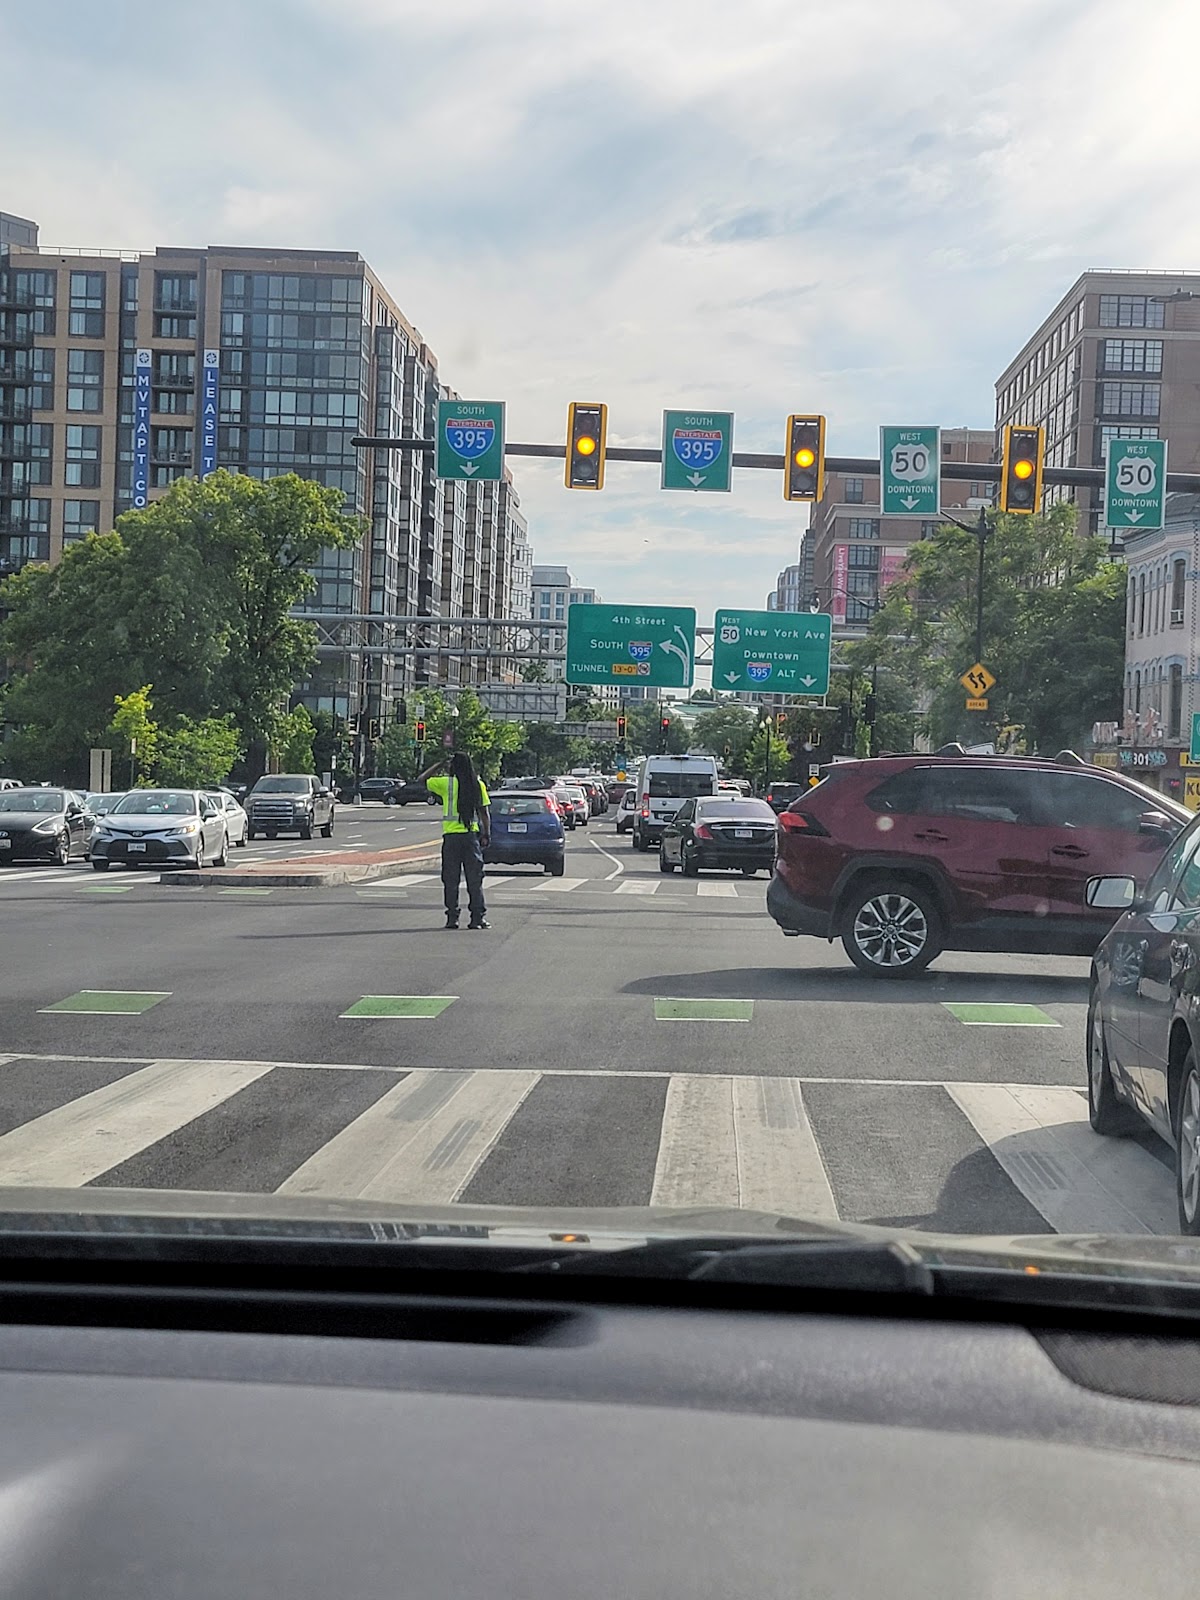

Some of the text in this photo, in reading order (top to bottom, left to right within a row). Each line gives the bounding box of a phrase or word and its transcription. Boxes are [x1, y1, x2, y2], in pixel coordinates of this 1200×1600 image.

[204, 371, 216, 446] LEASE
[456, 406, 485, 416] SOUTH
[450, 421, 490, 429] INTERSTATE
[684, 416, 713, 426] SOUTH
[453, 430, 487, 449] 395
[679, 431, 717, 440] INTERSTATE
[900, 432, 921, 441] WEST
[681, 440, 715, 460] 395
[1126, 445, 1148, 455] WEST
[895, 451, 927, 473] 50
[1120, 465, 1153, 486] 50
[887, 485, 933, 495] DOWNTOWN
[1111, 498, 1159, 508] DOWNTOWN
[611, 616, 666, 626] 4th Street
[721, 616, 740, 624] WEST
[722, 629, 738, 640] 50
[745, 627, 826, 640] New York Ave
[590, 638, 624, 650] SOUTH
[631, 647, 651, 657] 395
[743, 650, 799, 661] Downtown
[571, 663, 609, 673] TUNNEL
[751, 668, 796, 678] 395 ALT
